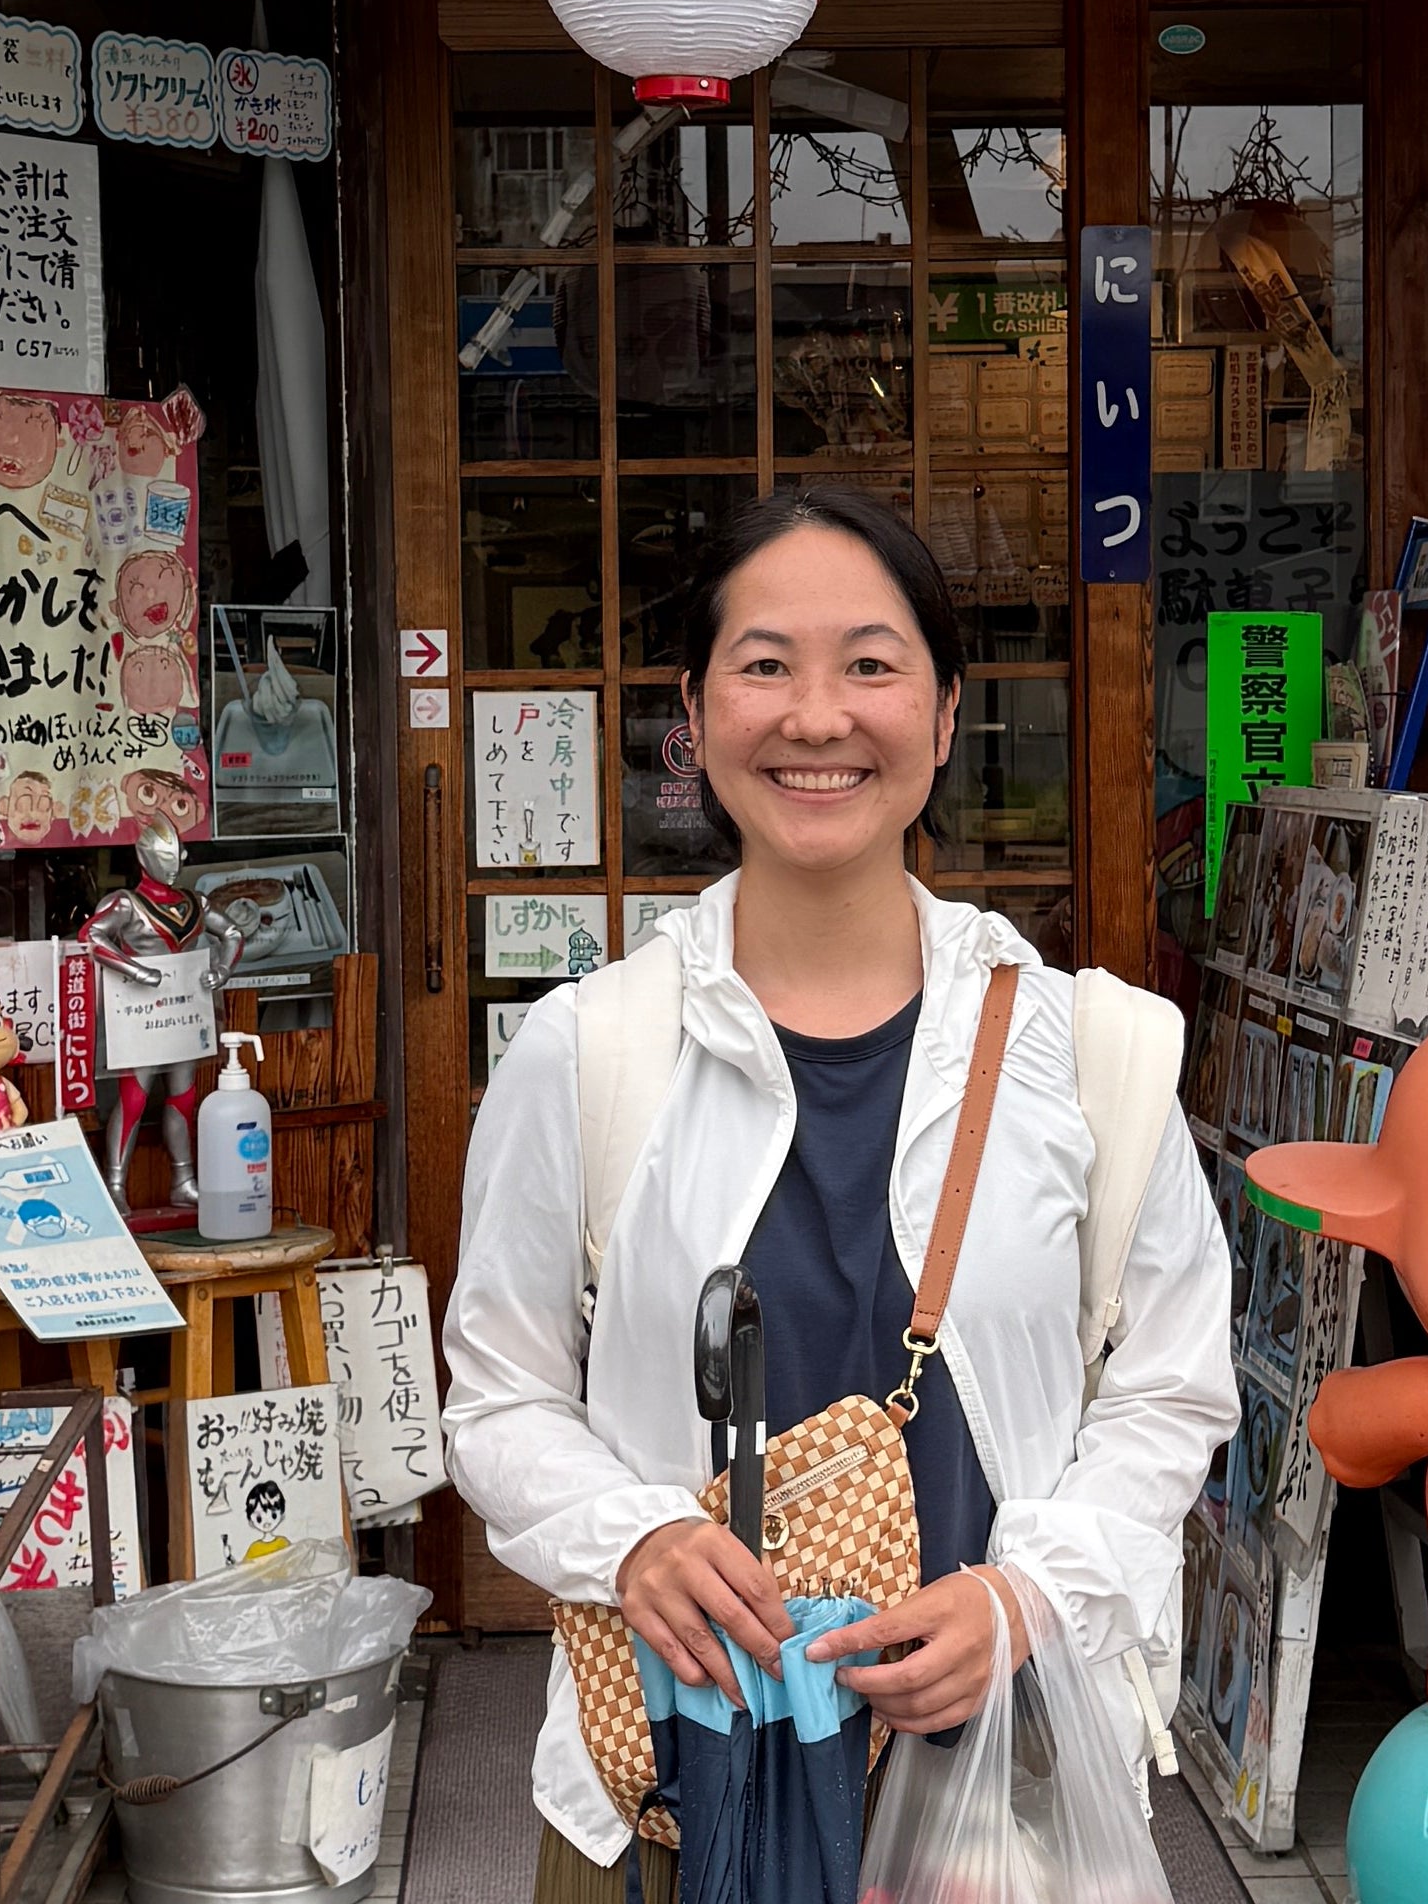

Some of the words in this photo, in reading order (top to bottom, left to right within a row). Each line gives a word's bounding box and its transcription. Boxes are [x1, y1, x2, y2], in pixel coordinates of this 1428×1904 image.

[105, 69, 211, 110] ソフトクリーム
[976, 290, 1068, 316] 1番改札
[16, 338, 53, 359] C57
[1093, 254, 1142, 549] にいつ
[1245, 350, 1259, 466] お客様の安心のために
[1160, 500, 1356, 559] ようこそ
[514, 702, 540, 763] 戸を
[485, 713, 511, 865] しめて下さい
[545, 697, 584, 864] 冷房中です
[492, 900, 585, 938] しずかに
[23, 1285, 158, 1308] ご入店をお控え下さい。
[370, 1278, 428, 1478] カゴを使って
